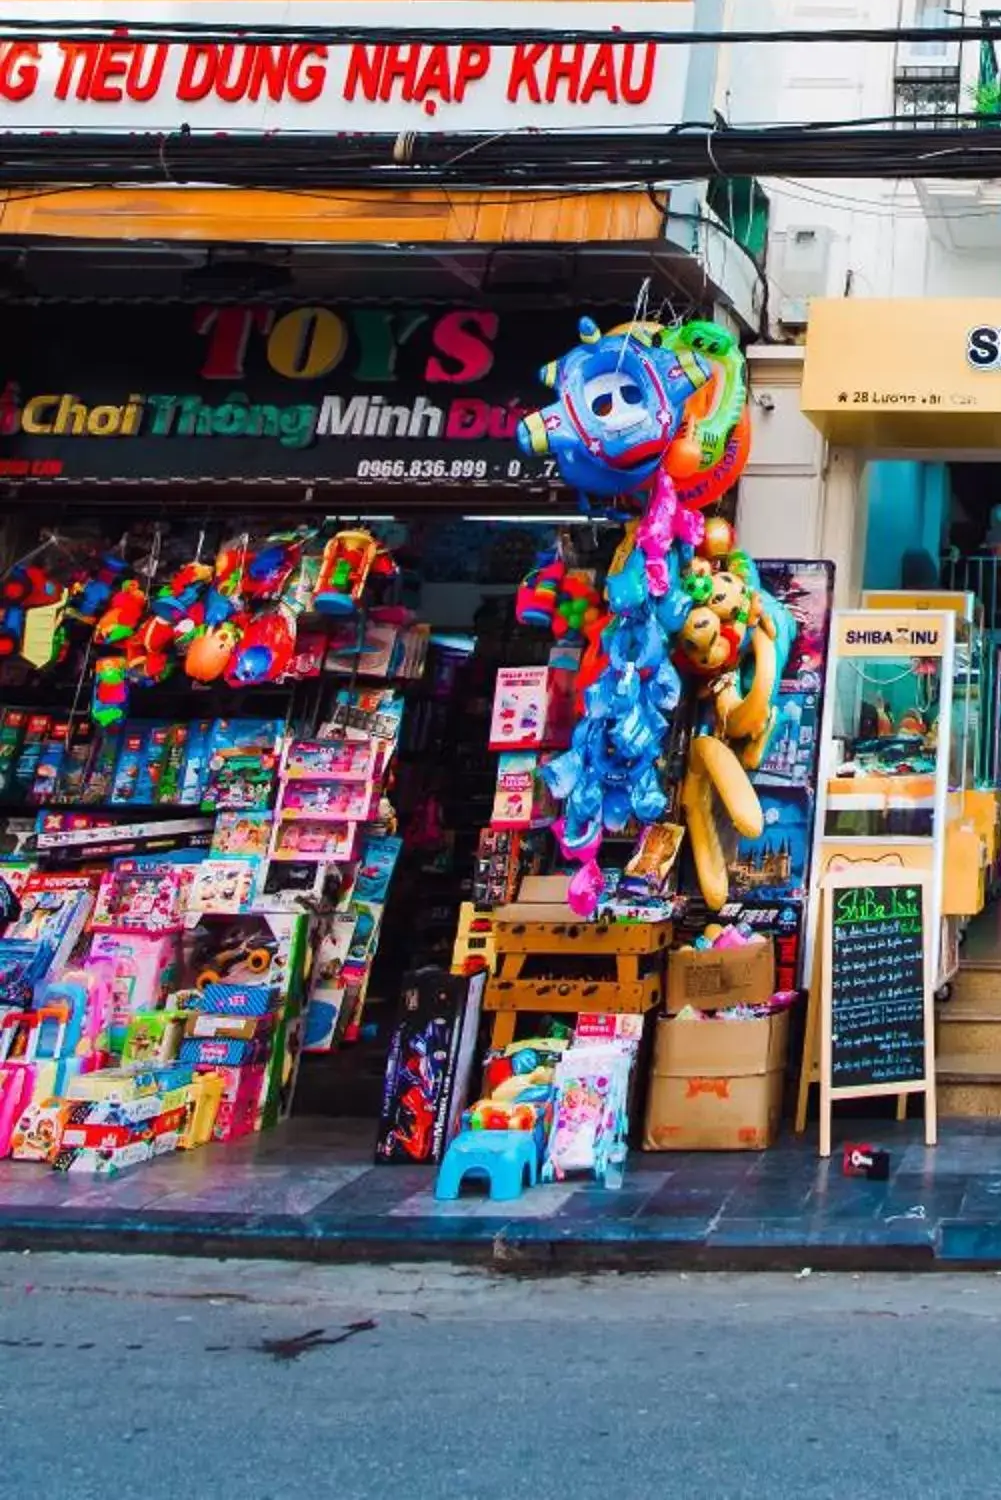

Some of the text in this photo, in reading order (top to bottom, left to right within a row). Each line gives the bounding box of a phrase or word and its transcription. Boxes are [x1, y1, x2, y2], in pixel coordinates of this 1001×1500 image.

[194, 306, 500, 384] TOYS
[852, 391, 869, 403] 28
[147, 391, 318, 448] Thông
[316, 395, 444, 438] Minh
[357, 459, 487, 478] 0966.836.899
[846, 631, 938, 645] SHIBA INU
